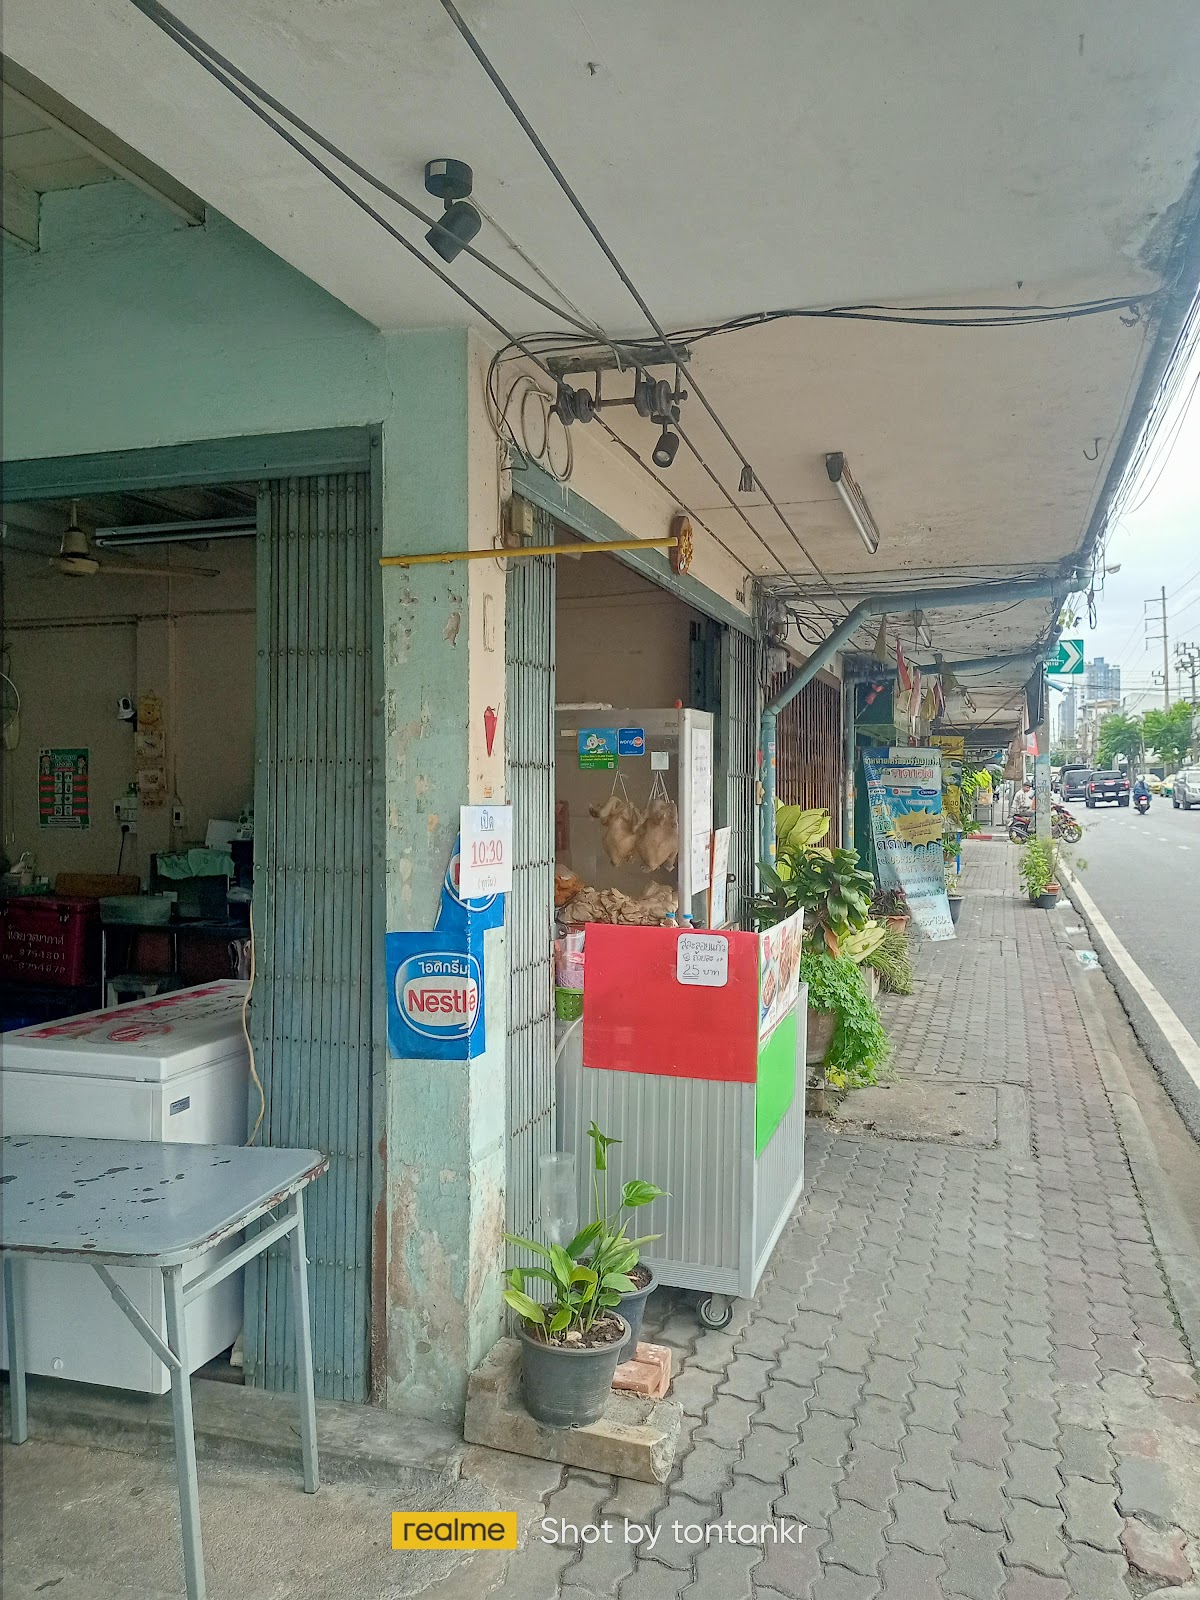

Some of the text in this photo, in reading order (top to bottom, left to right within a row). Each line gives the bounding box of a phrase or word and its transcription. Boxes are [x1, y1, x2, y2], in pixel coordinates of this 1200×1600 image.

[480, 809, 494, 830] เปิด
[471, 840, 503, 865] 10:30
[418, 959, 469, 975] ไอศกรีม
[683, 964, 700, 976] 25
[408, 987, 477, 1013] Nestlé
